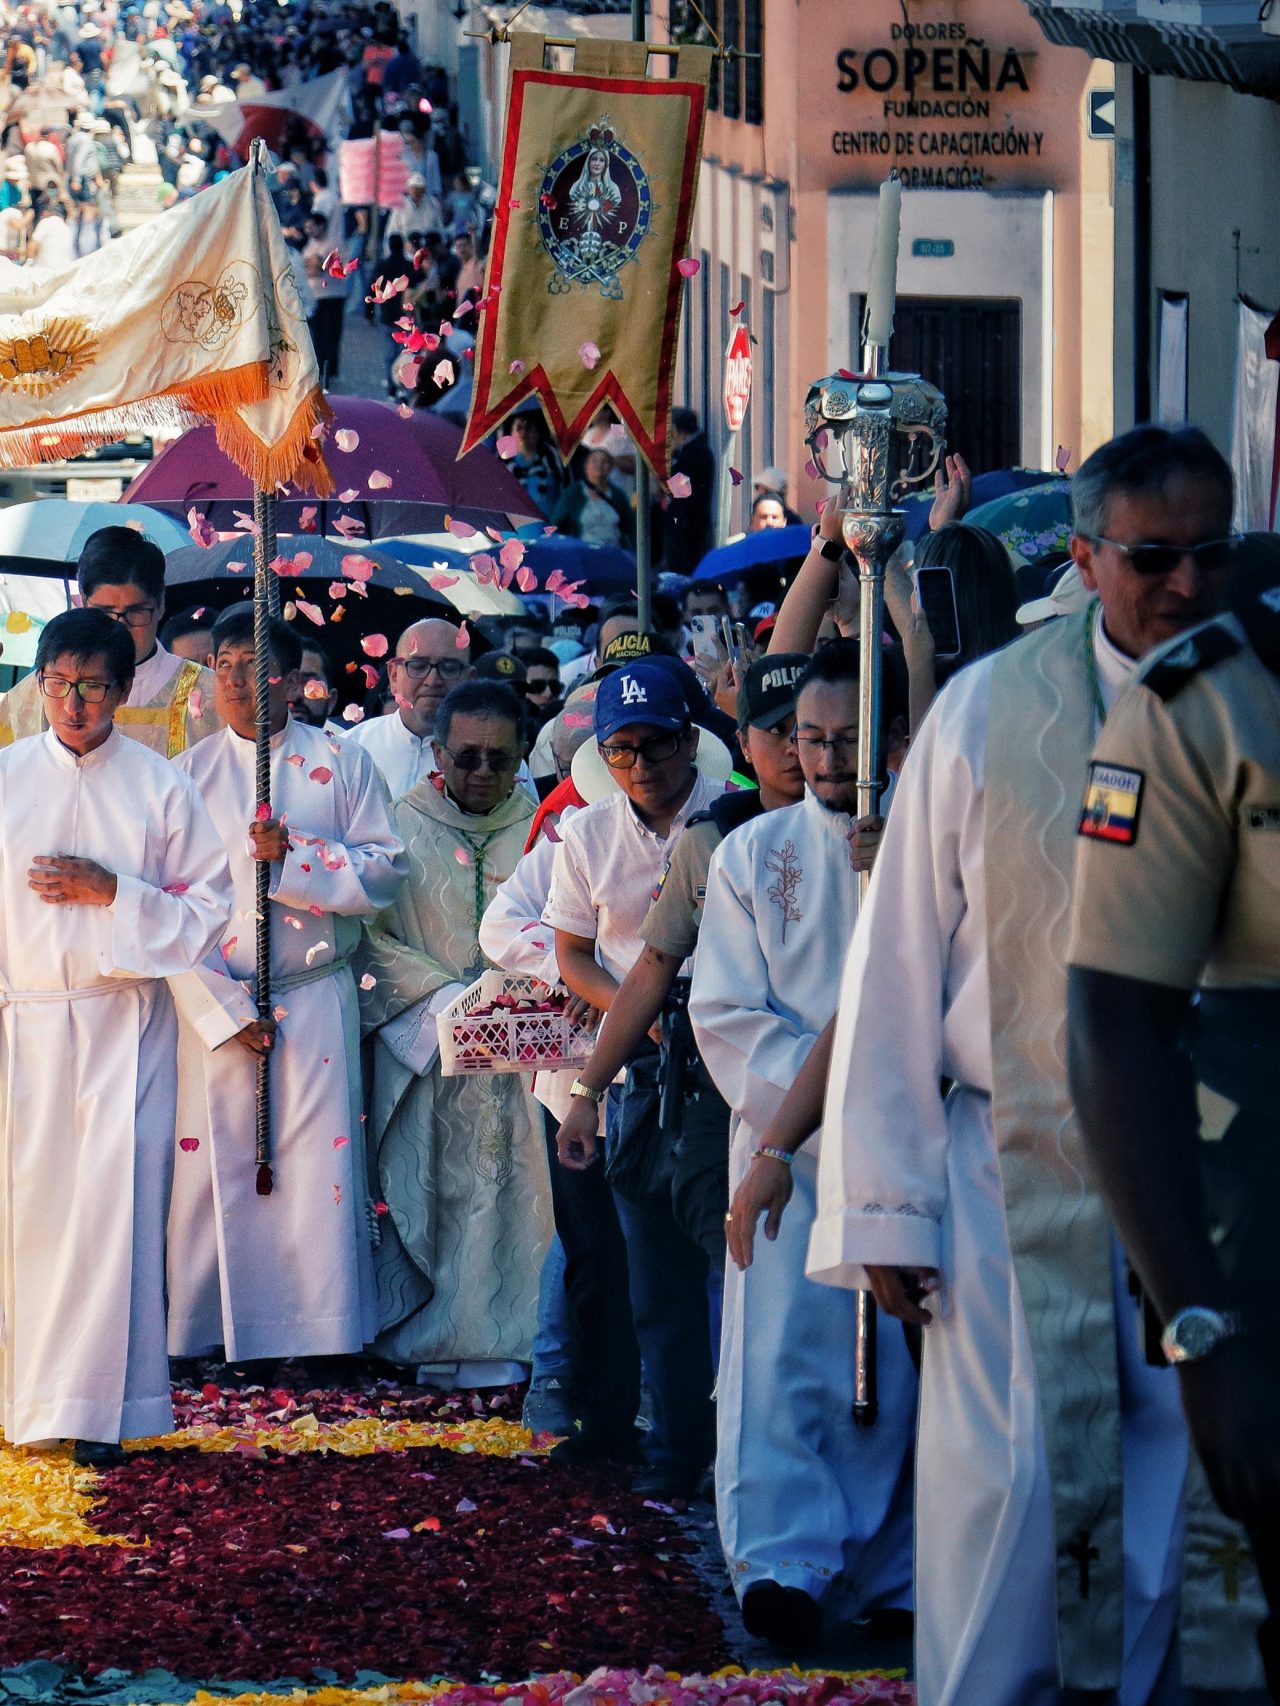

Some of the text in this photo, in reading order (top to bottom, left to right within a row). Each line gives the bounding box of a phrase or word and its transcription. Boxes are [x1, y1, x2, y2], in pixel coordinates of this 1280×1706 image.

[891, 22, 966, 41] DOLORES
[837, 38, 1030, 93] SOPEÑA
[884, 97, 990, 118] FUNDACIÓN
[832, 125, 1044, 156] CENTRO DE CAPACITACIÓN Y
[559, 217, 628, 234] E P
[606, 632, 651, 659] POLICÍA
[620, 674, 648, 705] LA
